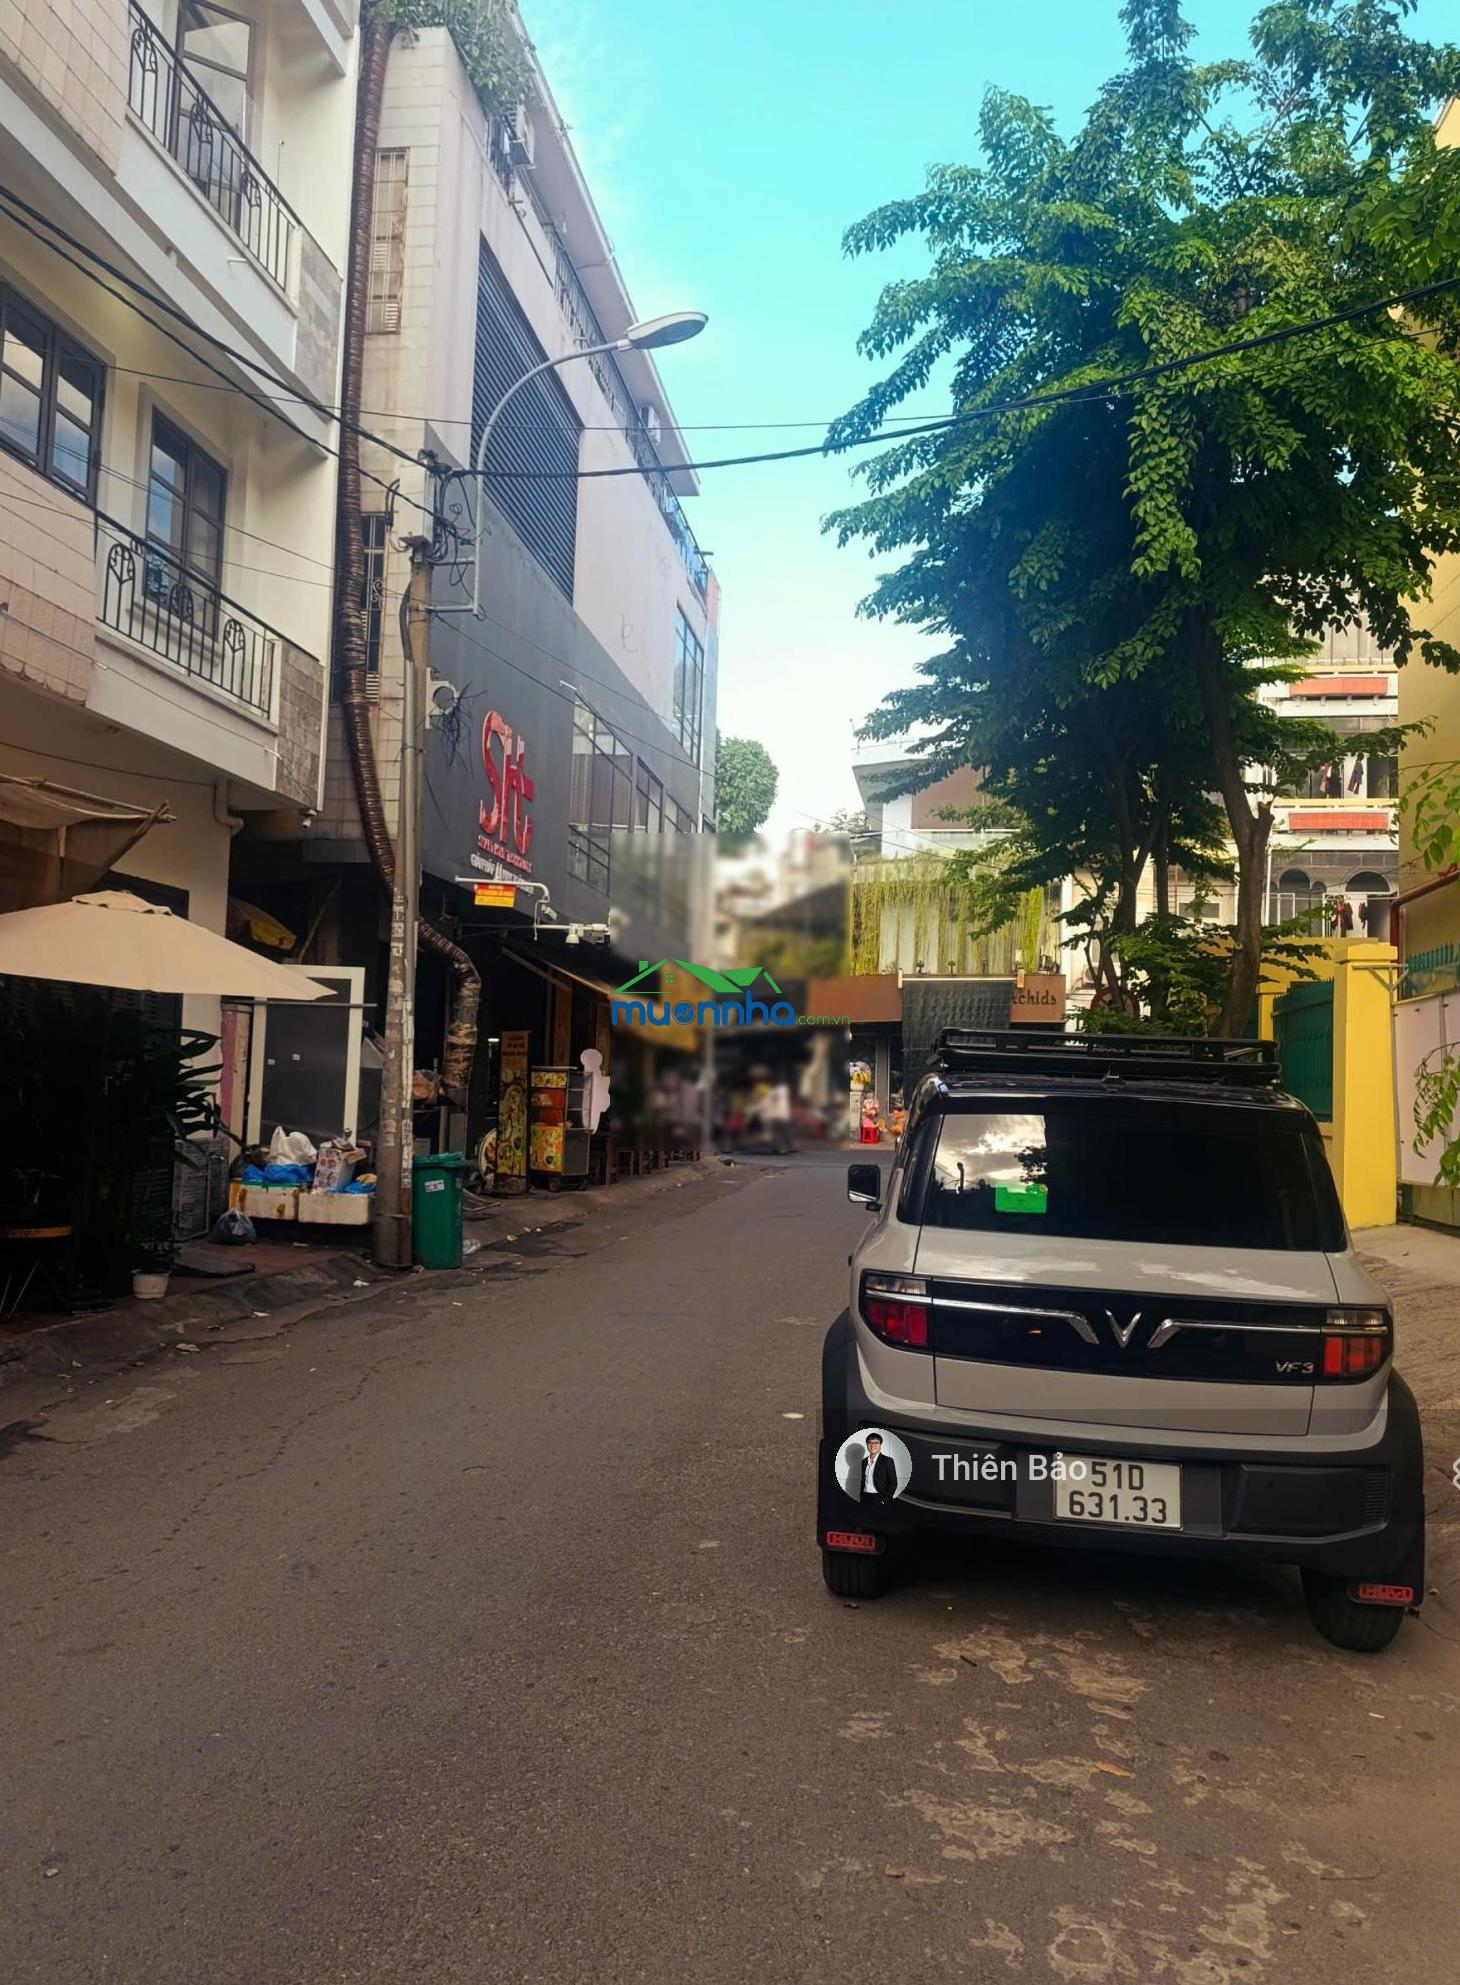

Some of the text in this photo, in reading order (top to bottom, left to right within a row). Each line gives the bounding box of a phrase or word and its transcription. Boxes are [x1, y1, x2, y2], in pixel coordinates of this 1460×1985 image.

[1011, 989, 1057, 1005] chids
[1090, 1461, 1145, 1491] 51D
[1068, 1490, 1168, 1525] 631.33
